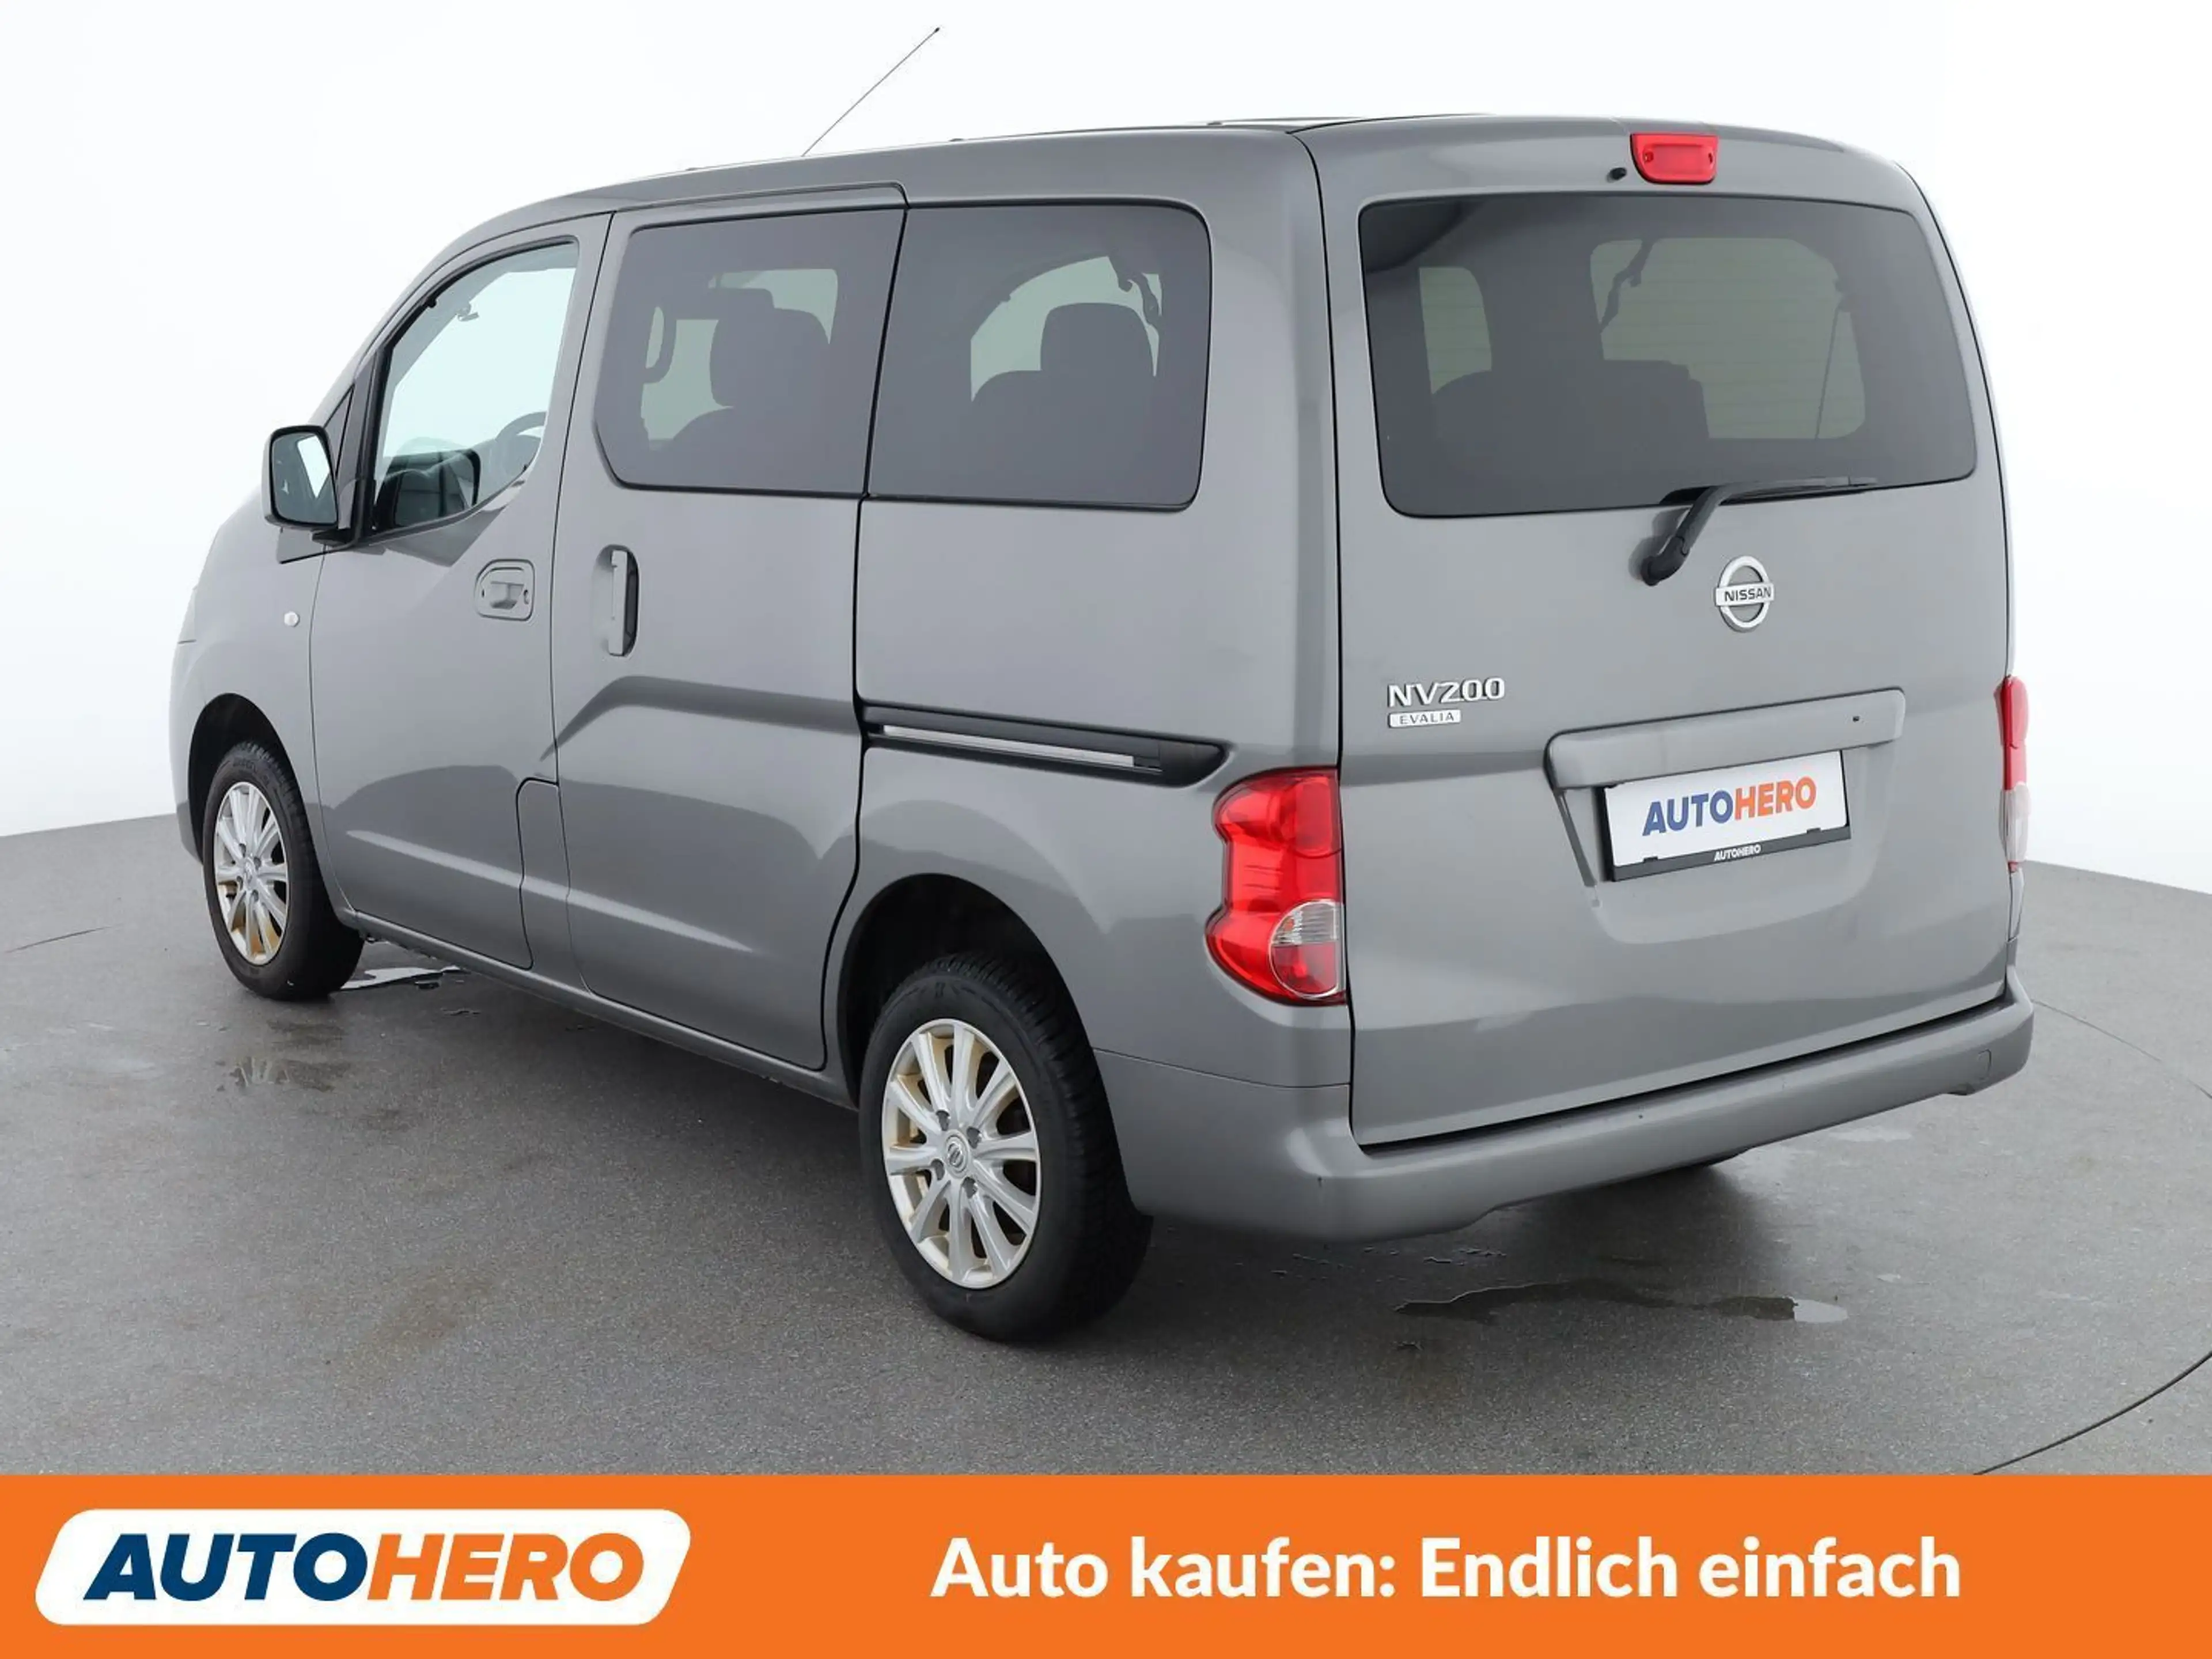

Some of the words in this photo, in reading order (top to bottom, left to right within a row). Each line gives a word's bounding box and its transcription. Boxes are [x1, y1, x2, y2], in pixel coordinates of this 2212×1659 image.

[1725, 586, 1771, 601] NISSAN
[1388, 677, 1505, 707] NV200
[1399, 711, 1455, 725] EVALIA
[1643, 776, 1817, 837] AUTOHERO
[1714, 843, 1762, 862] AUTOHERO
